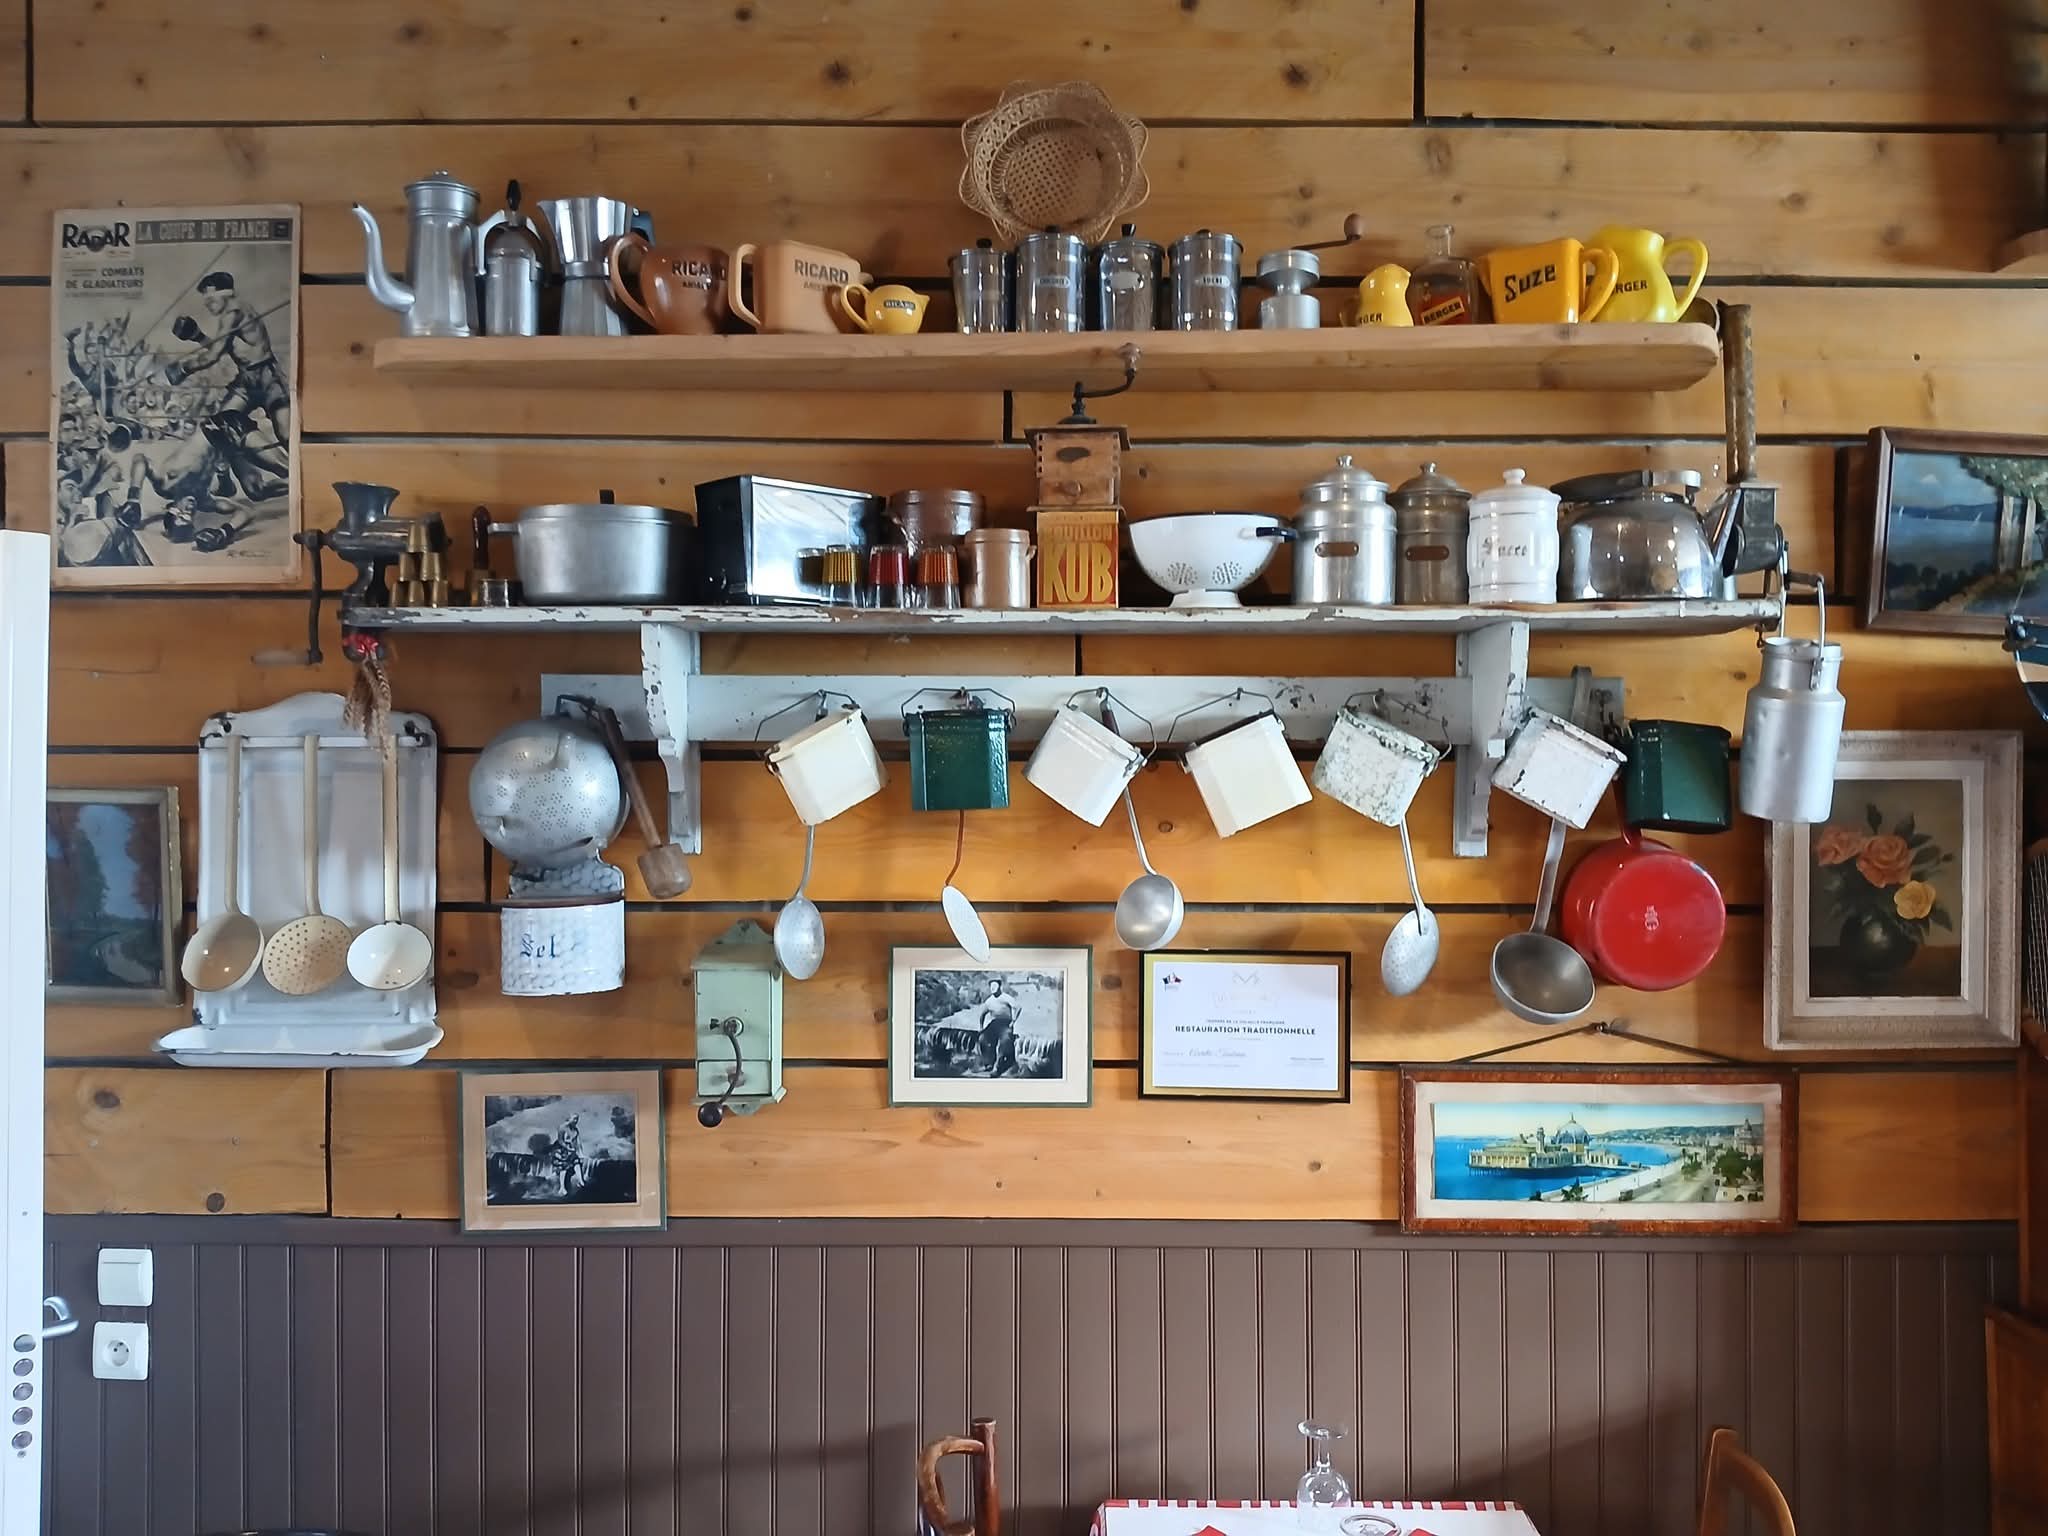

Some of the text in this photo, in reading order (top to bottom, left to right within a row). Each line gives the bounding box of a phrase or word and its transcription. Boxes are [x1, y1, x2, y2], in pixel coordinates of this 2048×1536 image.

[62, 222, 130, 251] RADAR
[138, 223, 153, 240] LA
[202, 222, 216, 239] DE
[223, 221, 270, 239] FRANCE
[101, 266, 145, 277] COMBATS
[794, 259, 849, 285] RICARD
[65, 279, 144, 289] DE GLADIATEURS
[1423, 302, 1462, 324] BERGER
[1043, 542, 1113, 602] KUB
[520, 932, 558, 957] Sel
[1175, 1025, 1316, 1036] RESTAURATION TRADITIONNELLE
